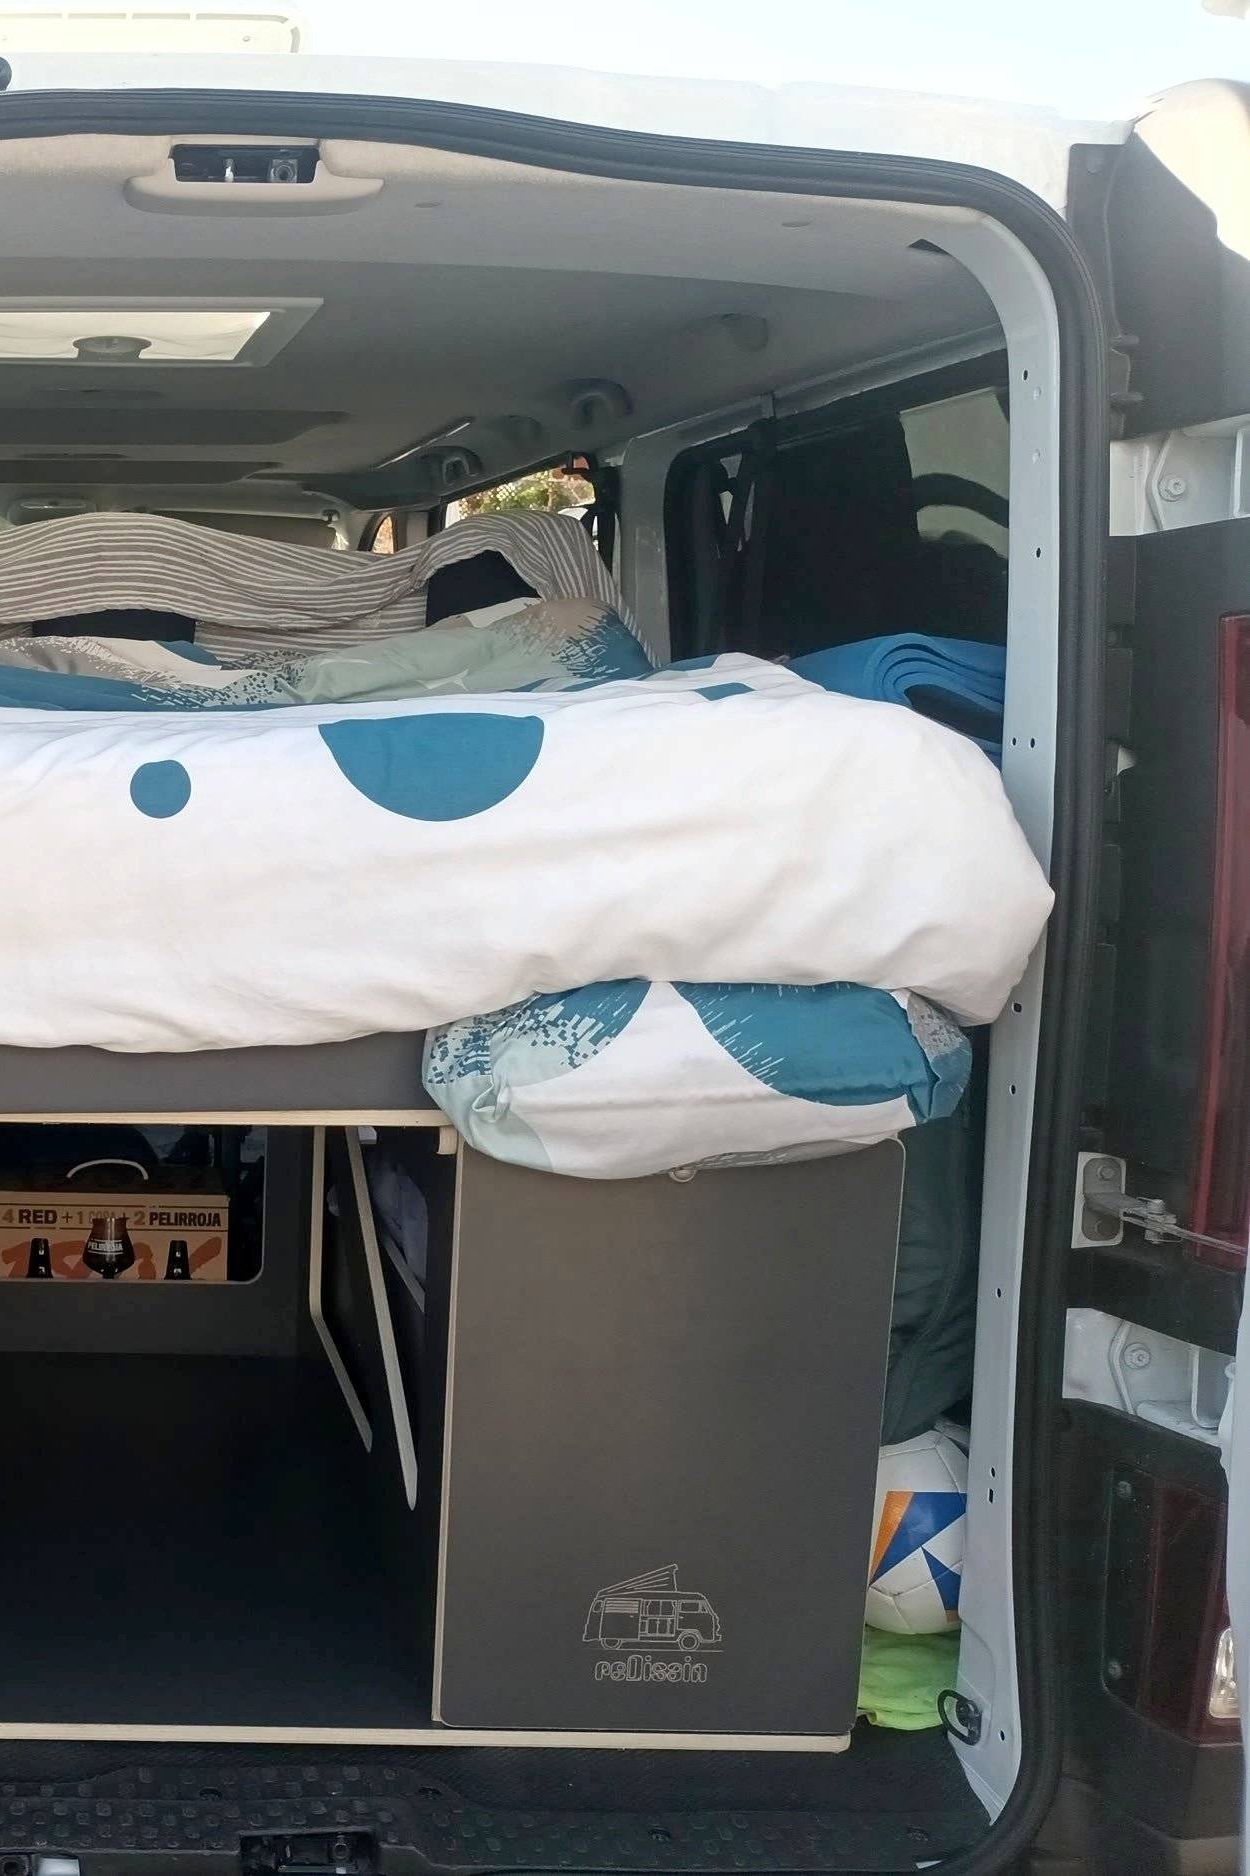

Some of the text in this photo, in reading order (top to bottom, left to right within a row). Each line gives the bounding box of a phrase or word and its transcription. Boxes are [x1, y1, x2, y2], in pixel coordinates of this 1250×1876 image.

[2, 1208, 14, 1223] 4
[18, 1209, 57, 1225] RED
[77, 1211, 83, 1224] 1
[134, 1211, 146, 1225] 2
[149, 1212, 221, 1227] PELIRROJA
